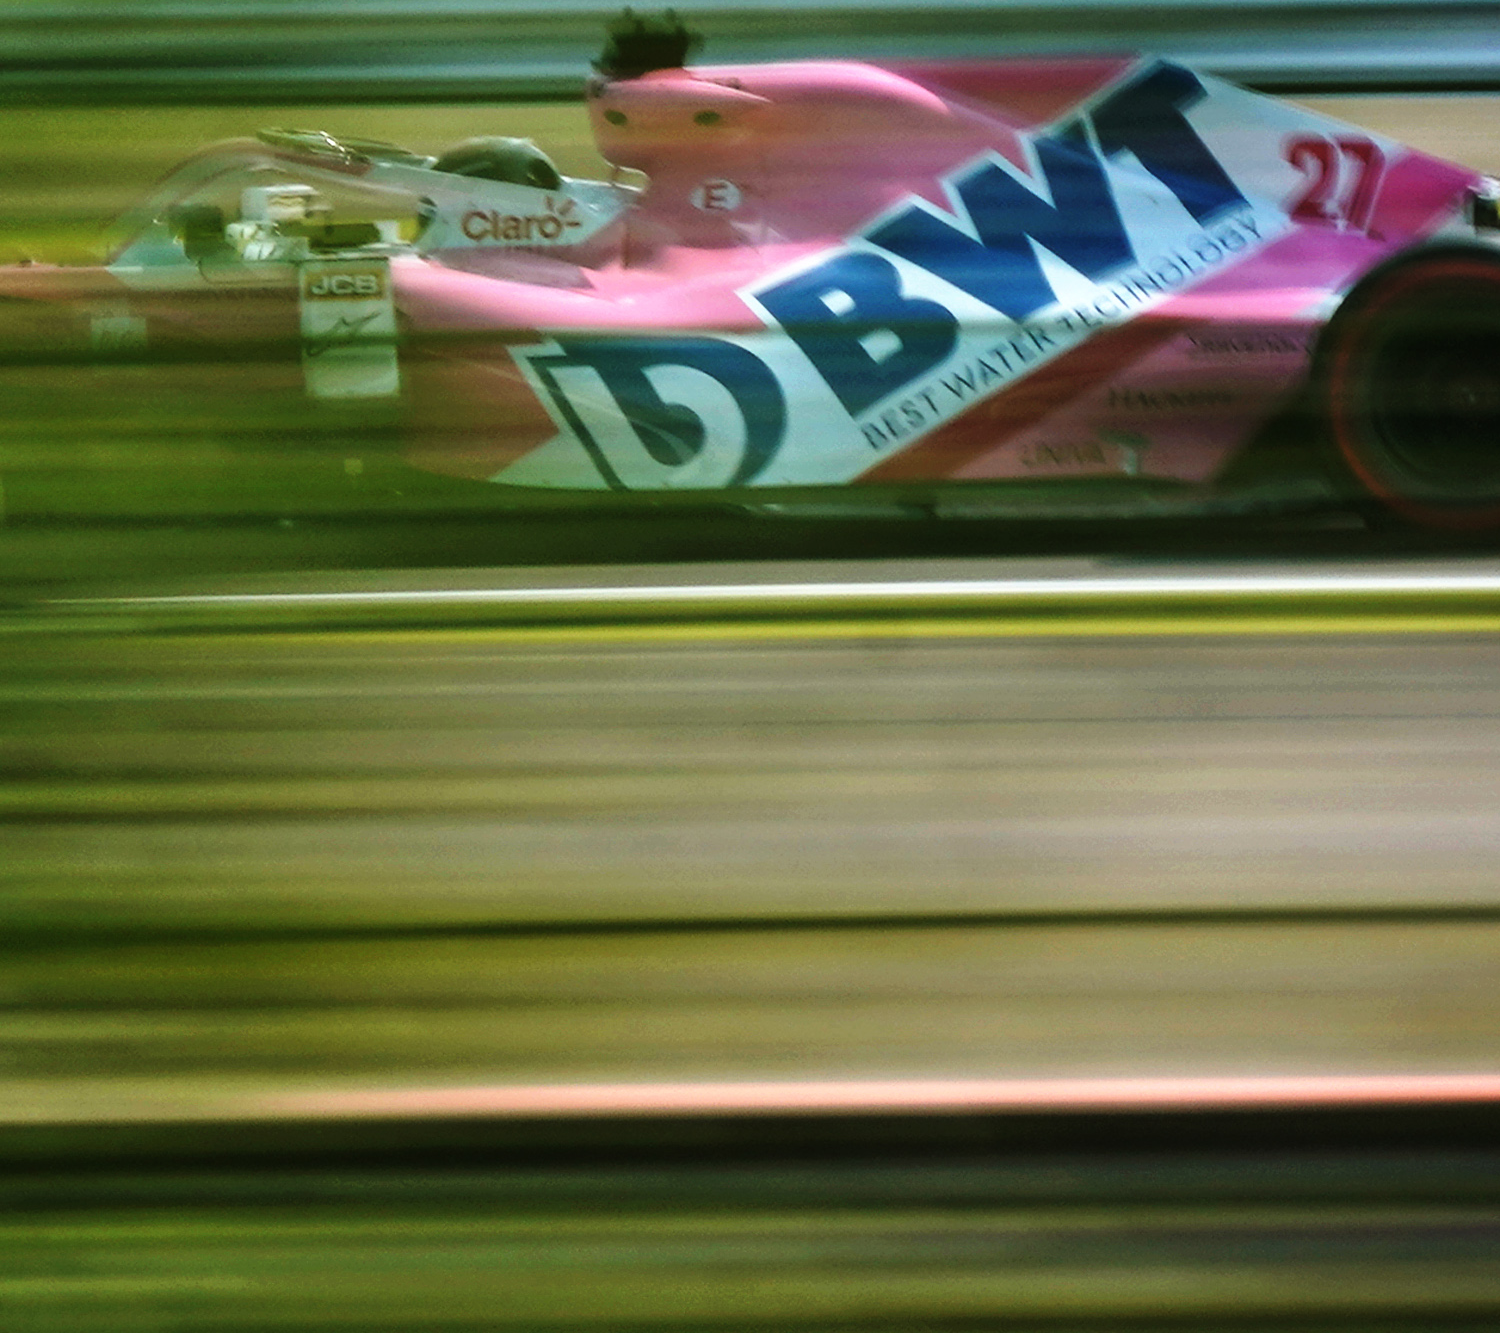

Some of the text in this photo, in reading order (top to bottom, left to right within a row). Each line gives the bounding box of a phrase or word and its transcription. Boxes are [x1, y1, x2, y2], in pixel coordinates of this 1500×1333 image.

[311, 275, 377, 294] JCB
[461, 209, 563, 241] Claro
[755, 59, 1251, 420] BWT
[860, 209, 1262, 450] BEST WATER TECHNOLOGY
